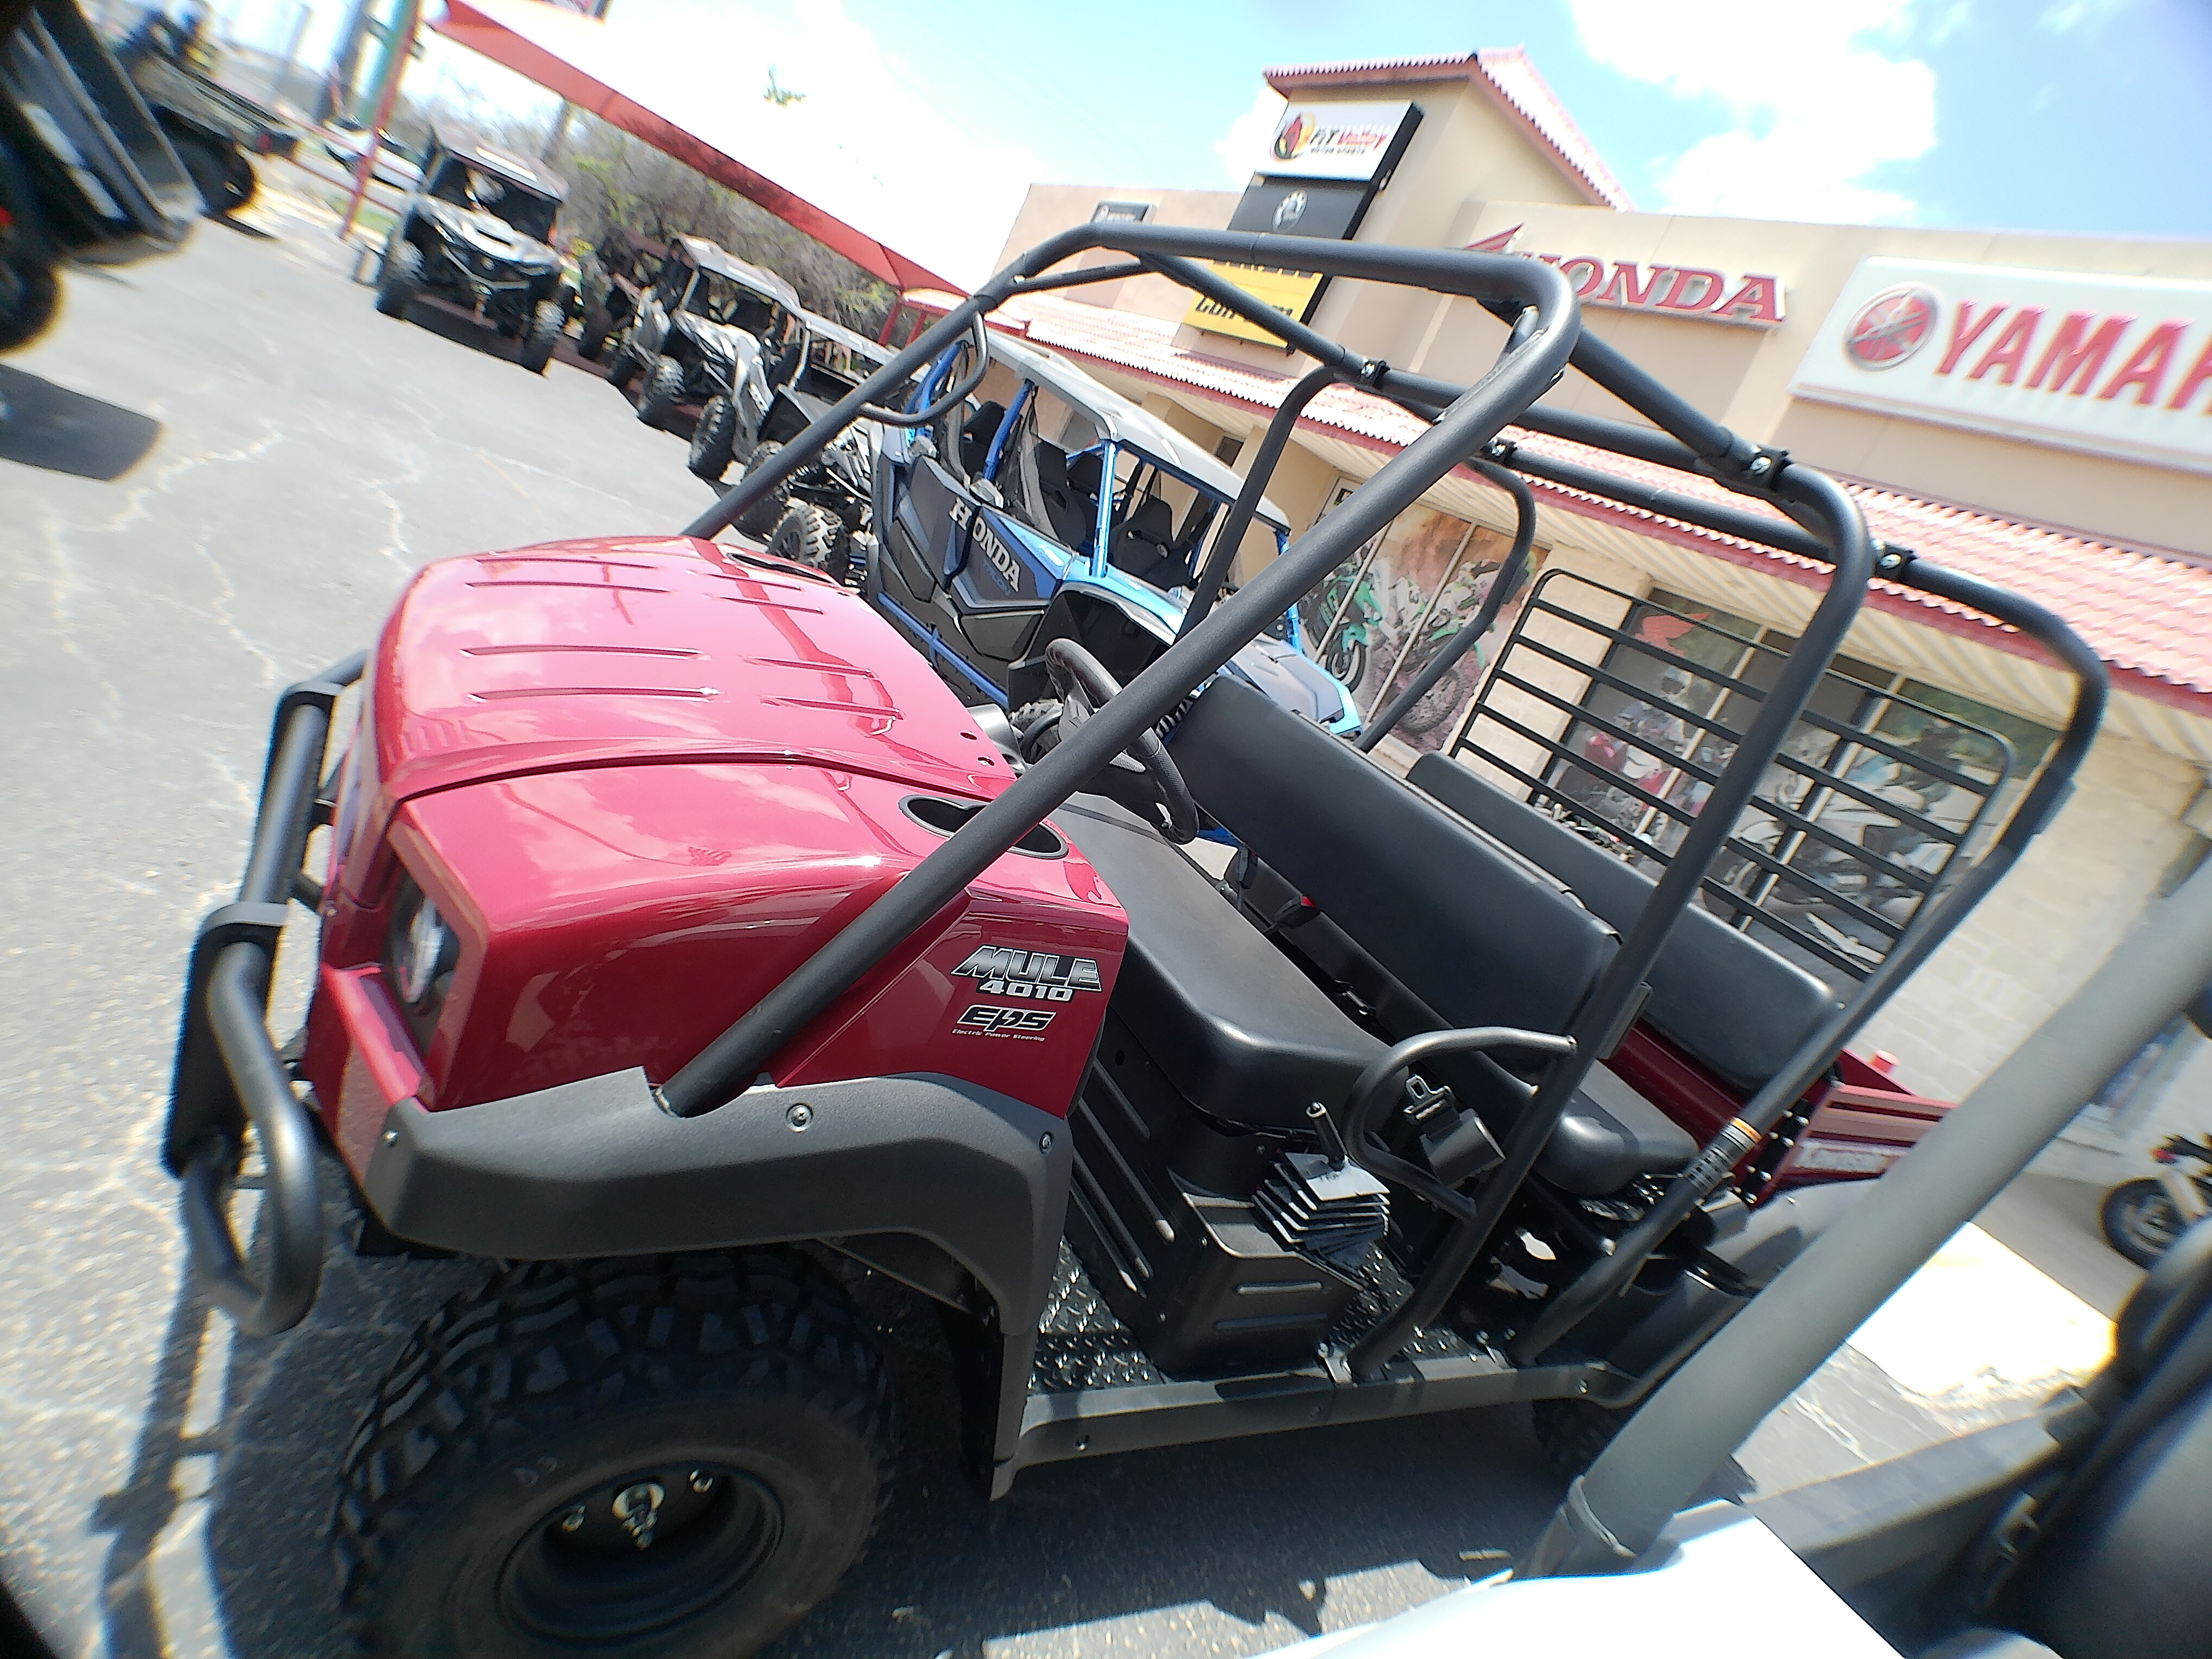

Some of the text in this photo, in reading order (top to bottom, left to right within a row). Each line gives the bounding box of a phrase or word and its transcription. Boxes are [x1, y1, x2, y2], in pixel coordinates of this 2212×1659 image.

[1520, 253, 1784, 323] ONDA
[949, 497, 1020, 593] HONDA
[950, 944, 1102, 992] MULE
[979, 980, 1073, 1002] 4010
